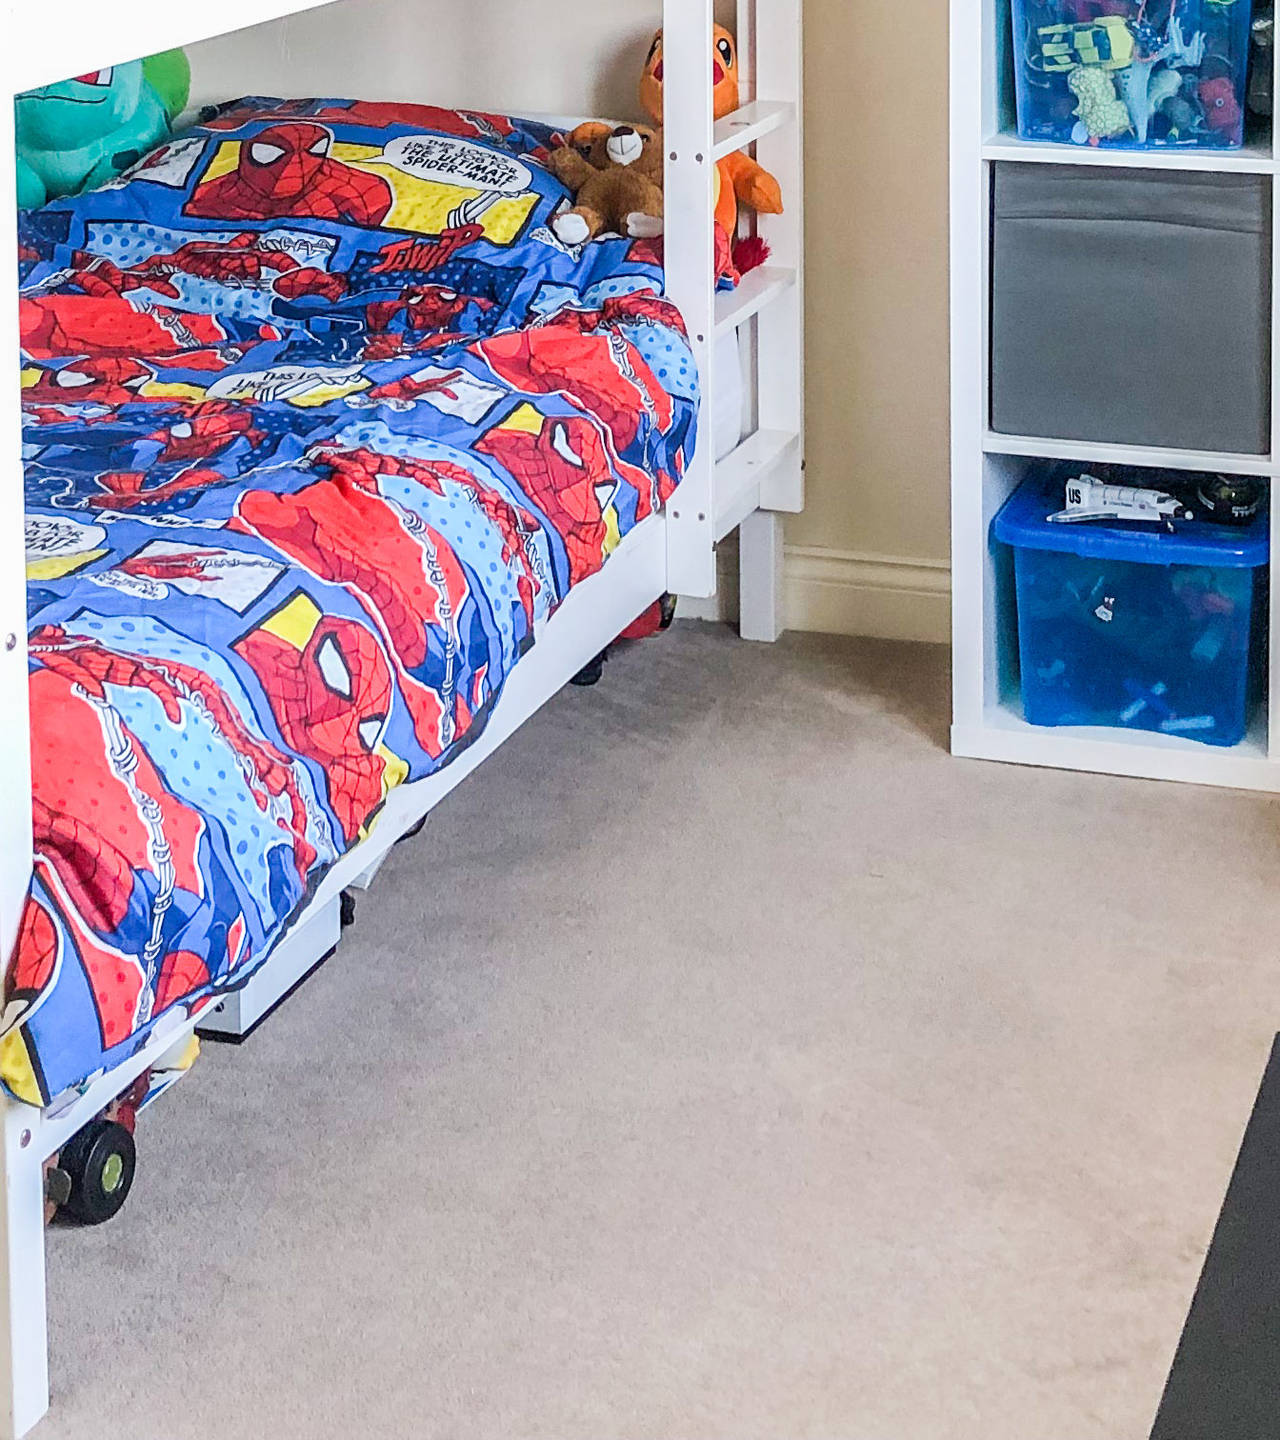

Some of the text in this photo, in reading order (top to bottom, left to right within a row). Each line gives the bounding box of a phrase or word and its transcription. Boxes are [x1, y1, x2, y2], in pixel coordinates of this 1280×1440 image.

[427, 139, 456, 150] THIS
[400, 146, 519, 183] THE ULTIMATE
[402, 155, 509, 189] SPIDER-MAN!
[489, 160, 518, 175] FOR
[1068, 487, 1081, 505] US
